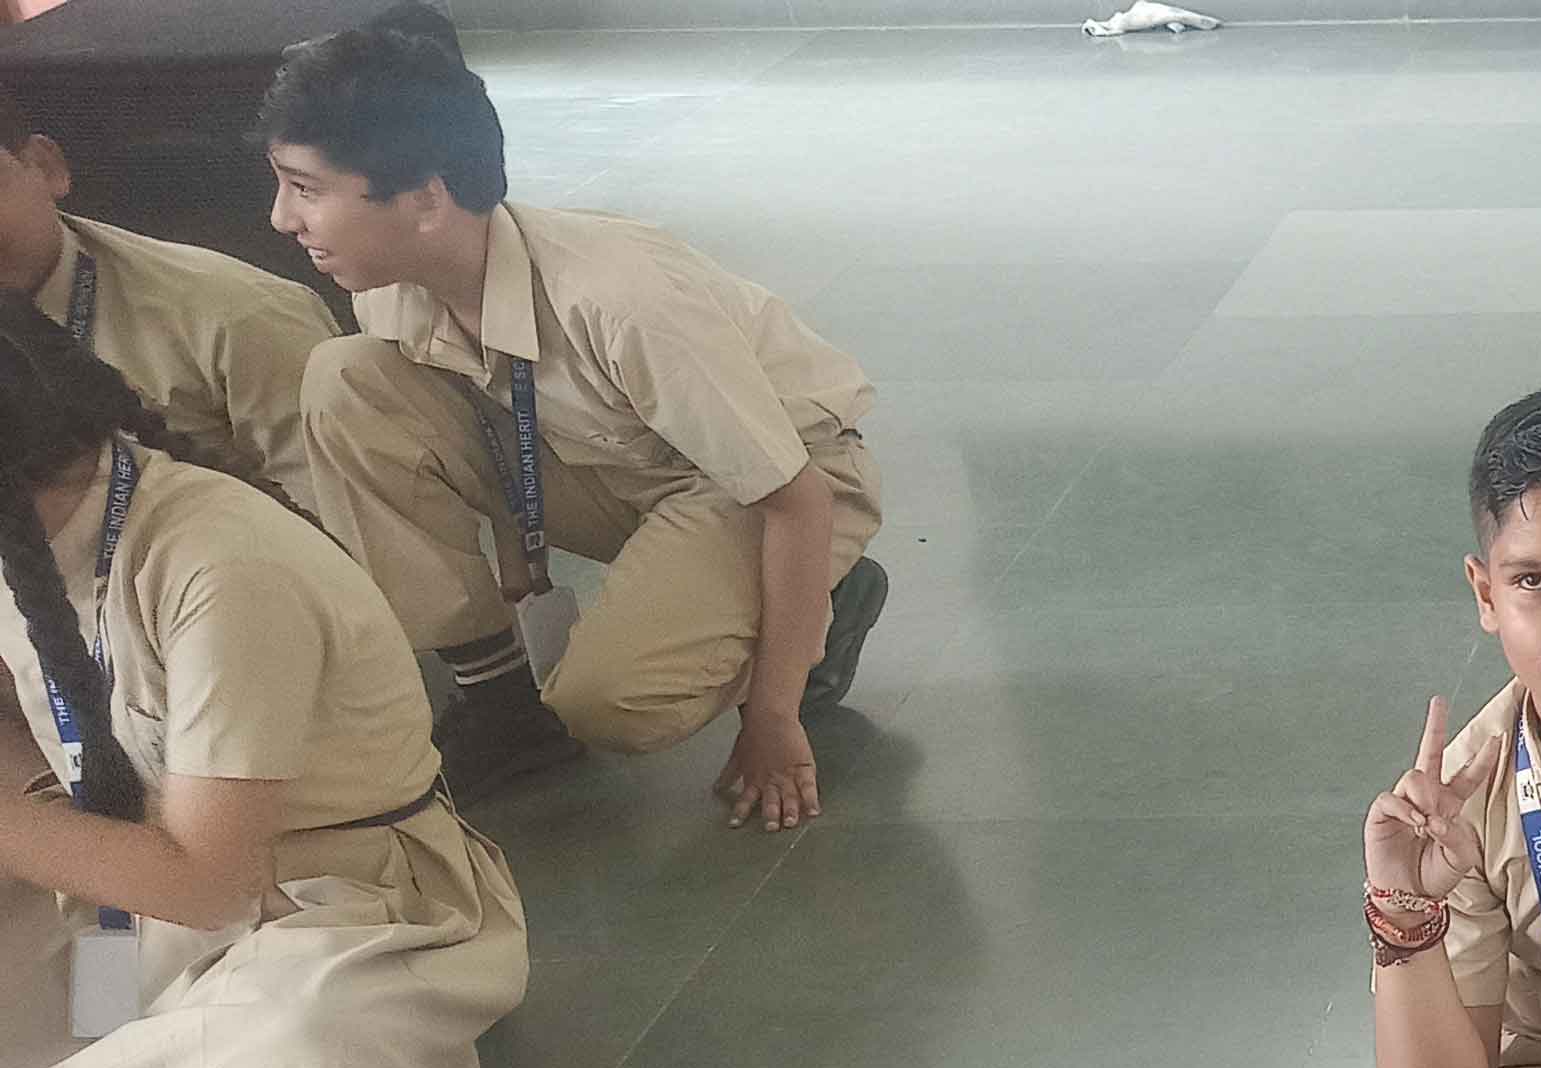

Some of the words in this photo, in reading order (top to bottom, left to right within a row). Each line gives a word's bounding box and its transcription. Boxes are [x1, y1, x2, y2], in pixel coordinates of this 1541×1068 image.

[522, 452, 537, 499] INDIAN
[108, 479, 131, 532] INDIAN
[527, 500, 539, 527] THE
